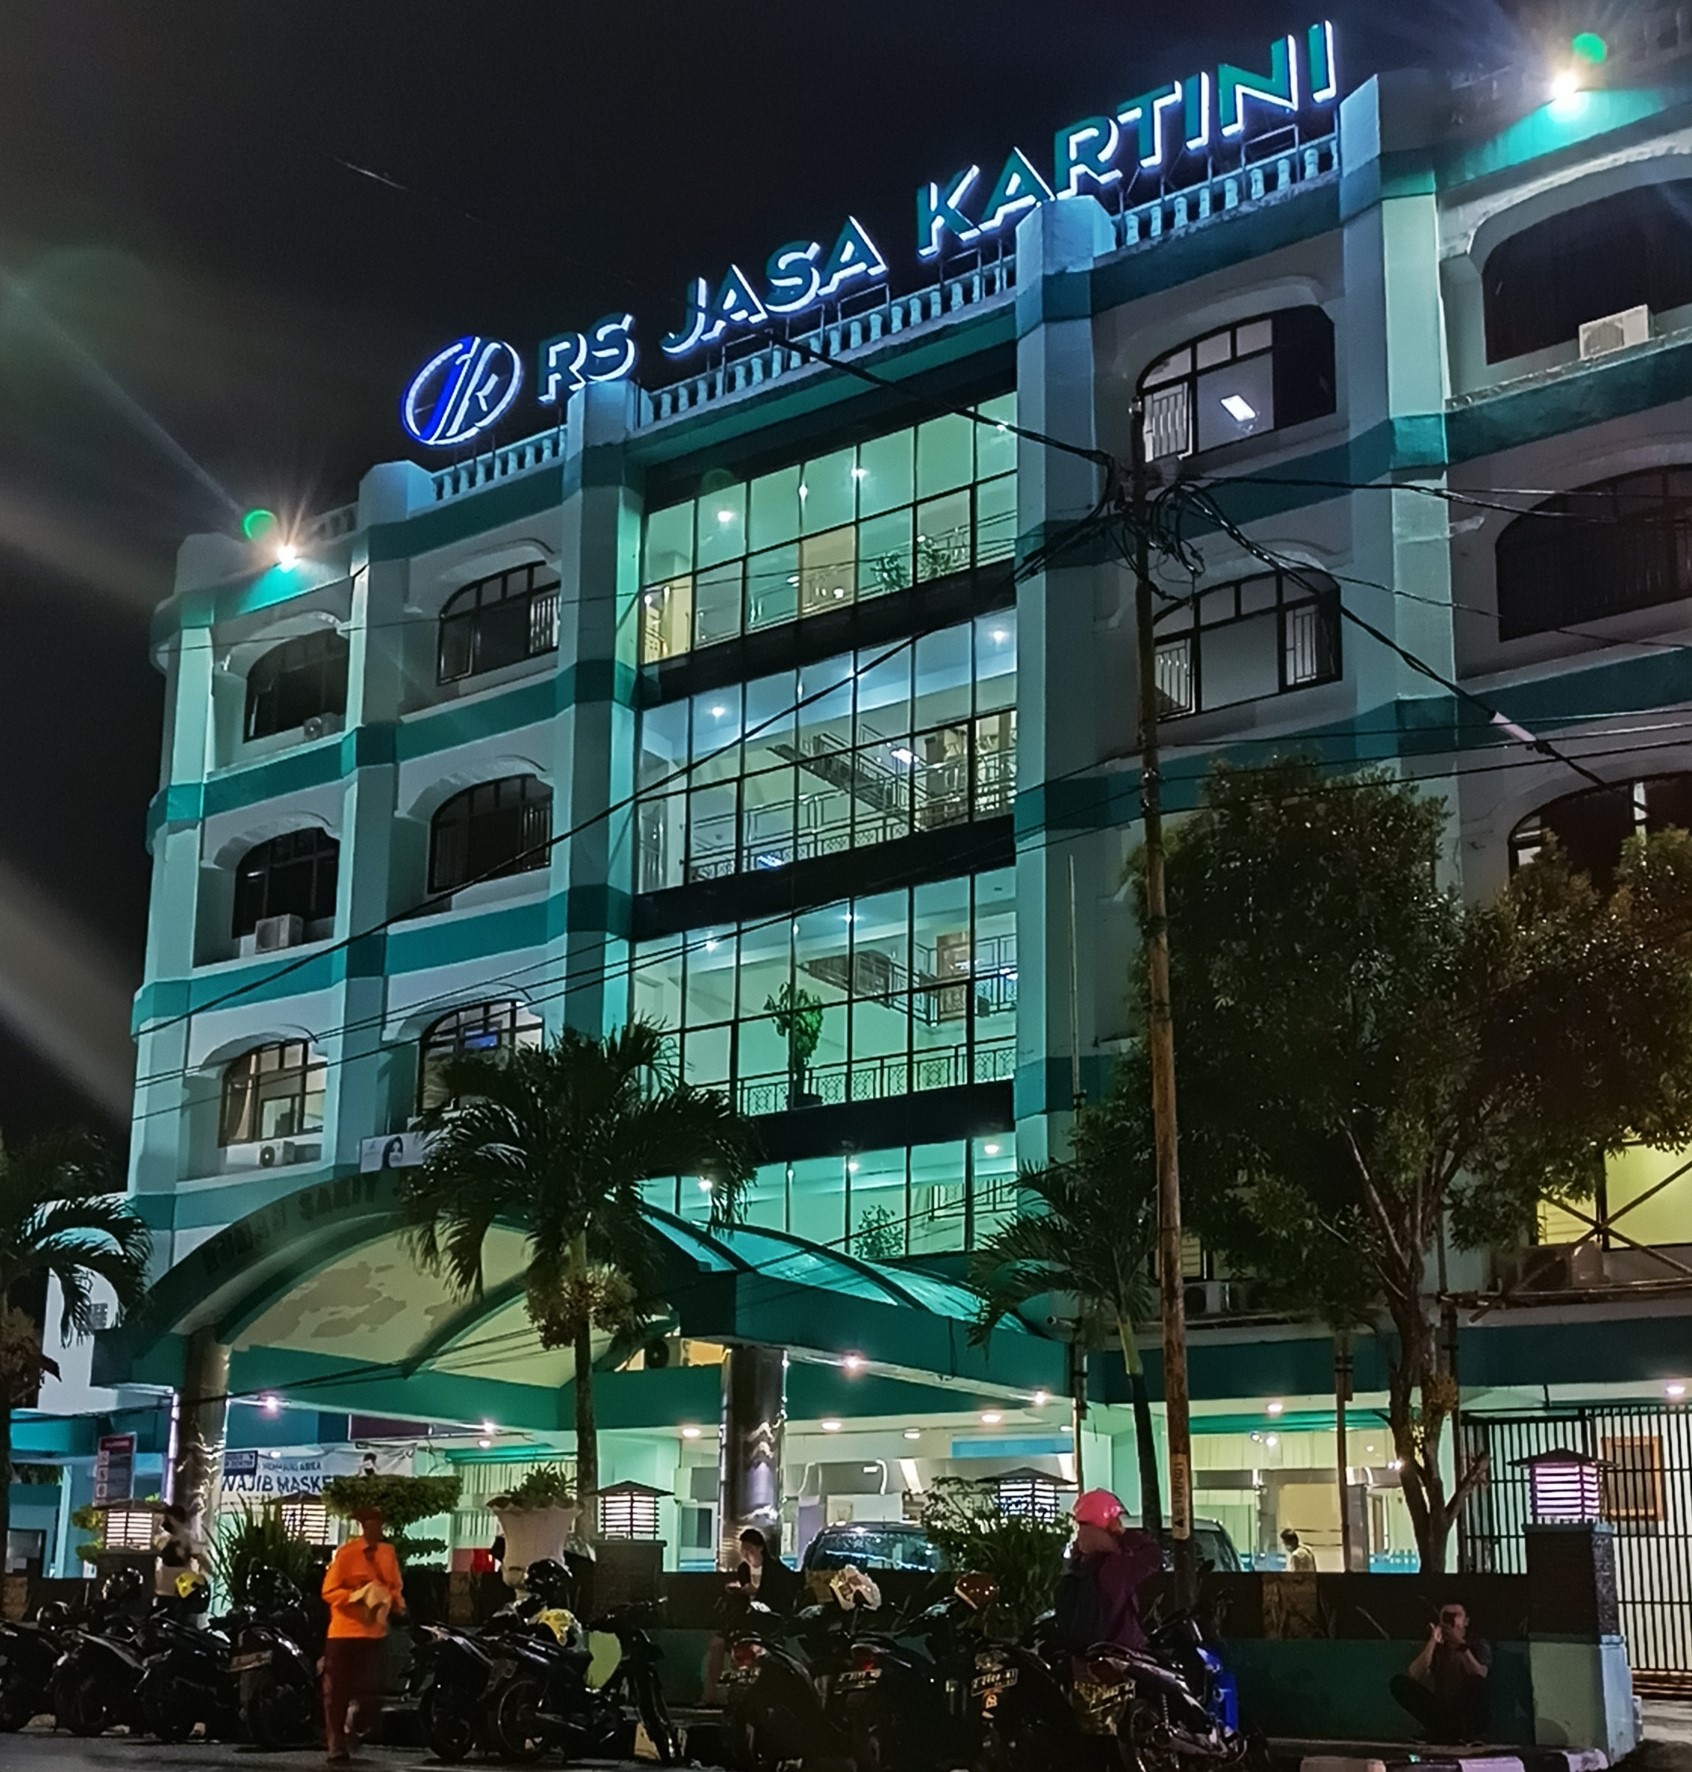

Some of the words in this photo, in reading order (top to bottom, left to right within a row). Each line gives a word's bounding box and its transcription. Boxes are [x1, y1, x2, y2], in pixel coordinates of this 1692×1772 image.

[538, 312, 637, 403] RS
[661, 215, 889, 354] JASA
[916, 19, 1337, 258] KARTINI
[221, 1474, 274, 1492] WAJIB
[276, 1475, 334, 1493] MASKE
